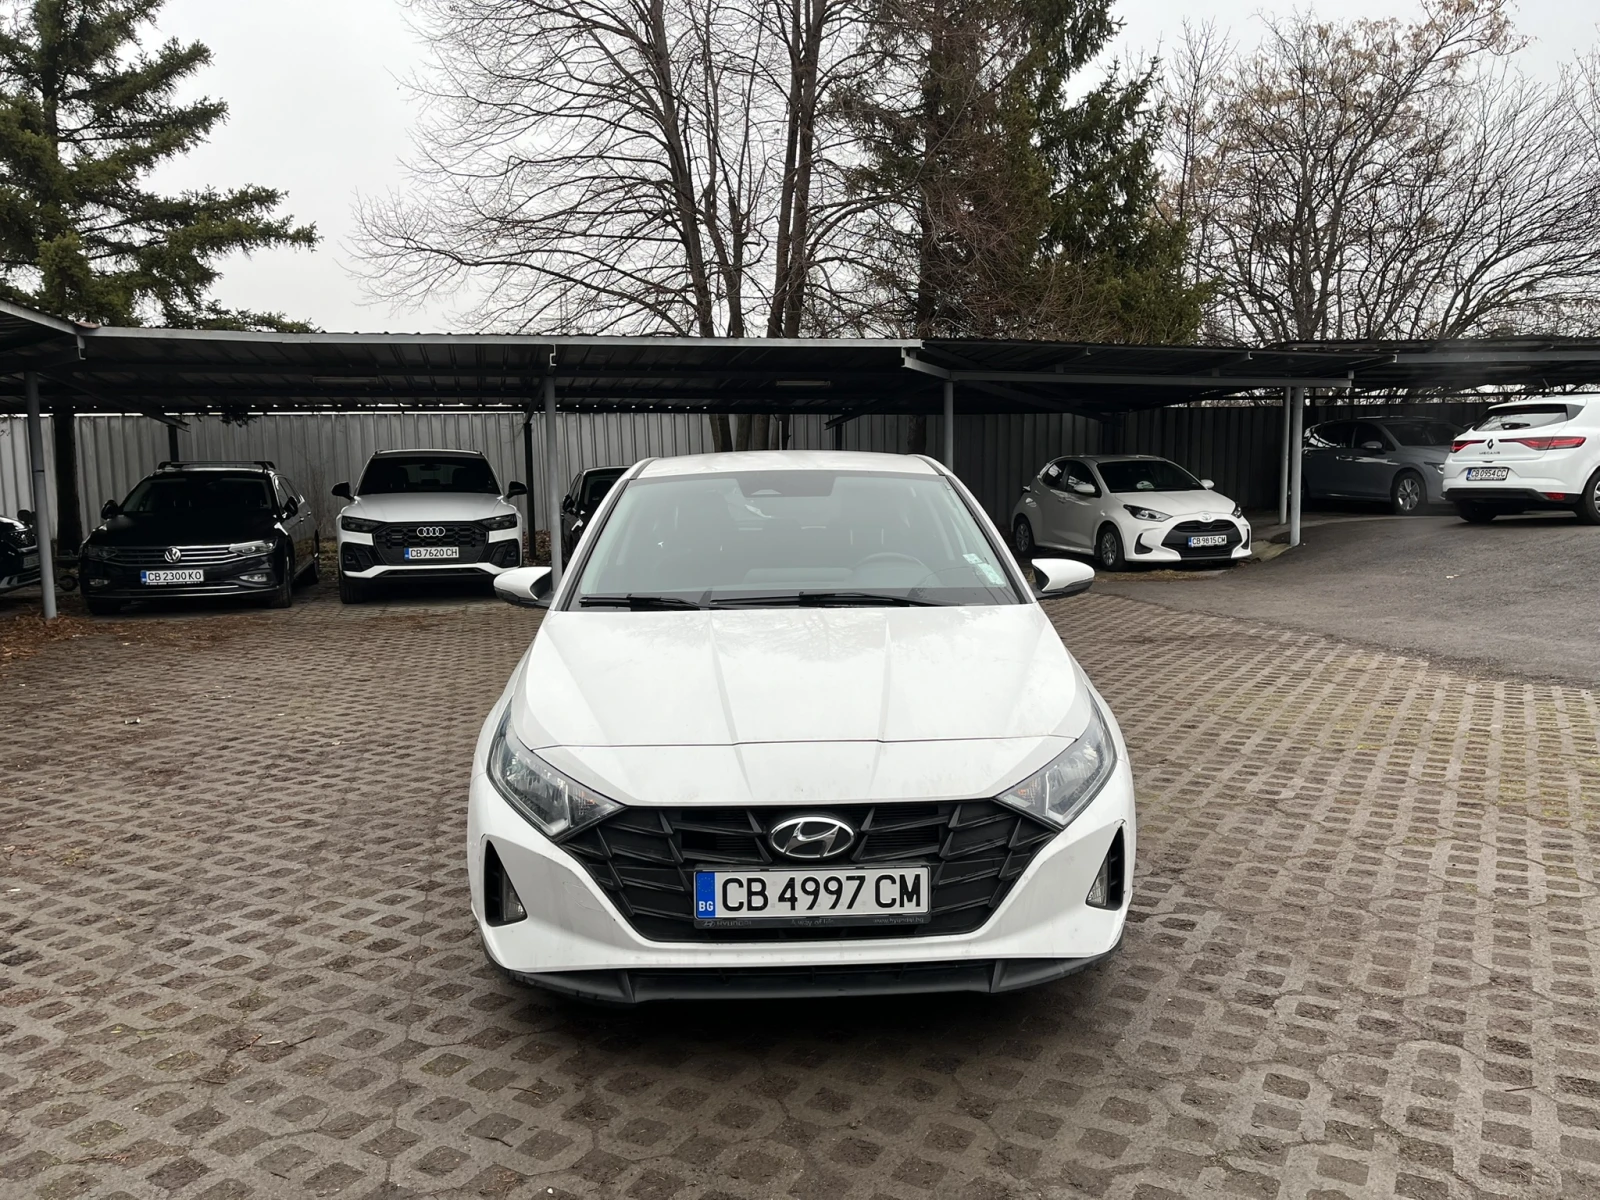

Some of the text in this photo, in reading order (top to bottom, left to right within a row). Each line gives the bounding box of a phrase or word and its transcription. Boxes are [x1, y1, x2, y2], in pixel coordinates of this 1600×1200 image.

[423, 549, 444, 557] 7620
[446, 548, 457, 556] CH
[148, 571, 202, 581] CB 2300 KO
[722, 873, 921, 911] CB 4997 CM
[699, 901, 714, 912] BG
